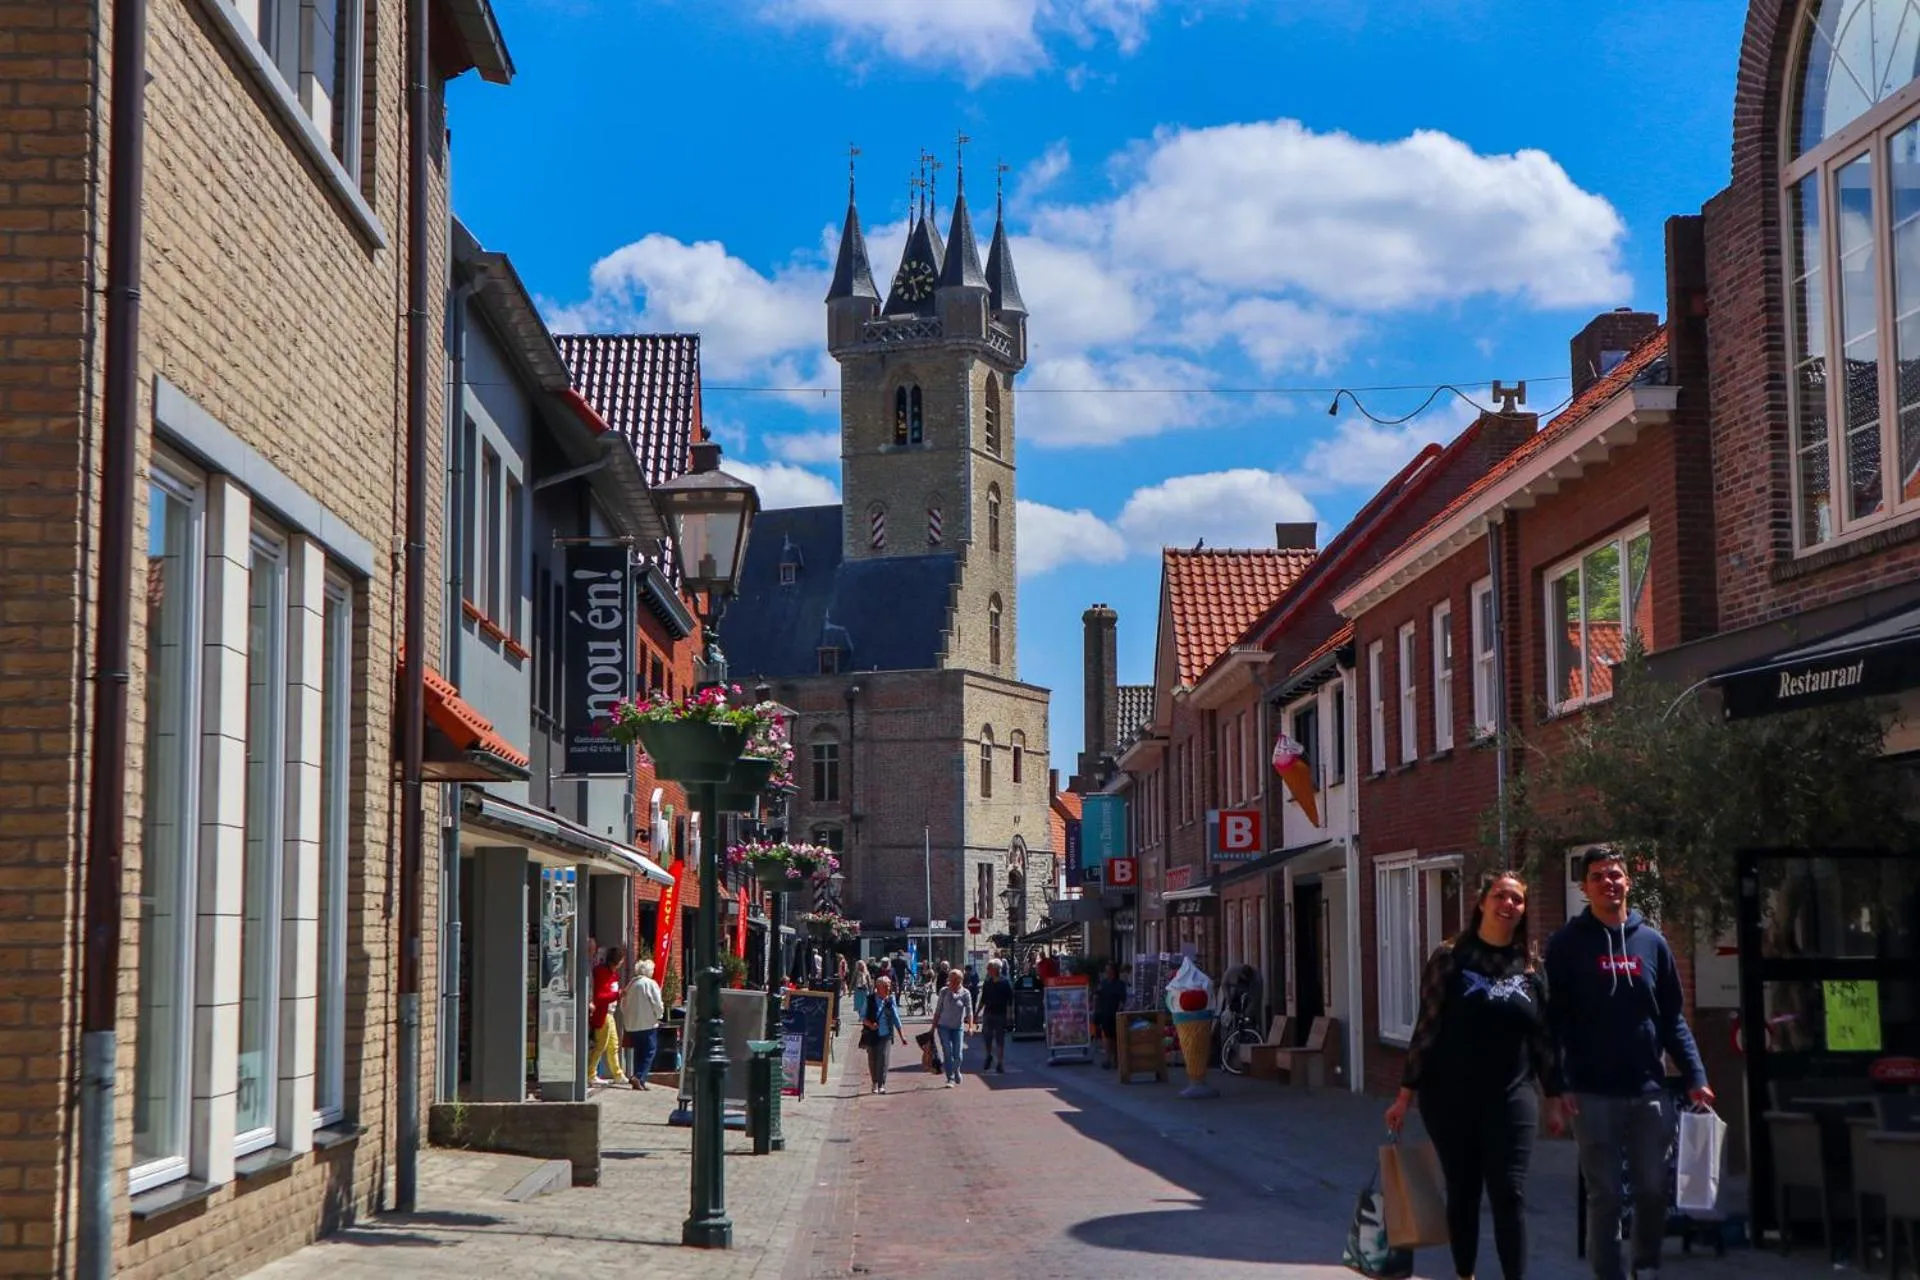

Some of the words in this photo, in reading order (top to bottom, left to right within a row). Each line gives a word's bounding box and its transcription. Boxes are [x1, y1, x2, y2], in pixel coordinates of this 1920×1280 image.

[568, 569, 624, 631] én!
[586, 638, 623, 721] nou
[1778, 660, 1864, 698] Restaurant
[1226, 815, 1253, 848] B
[1115, 860, 1131, 882] B
